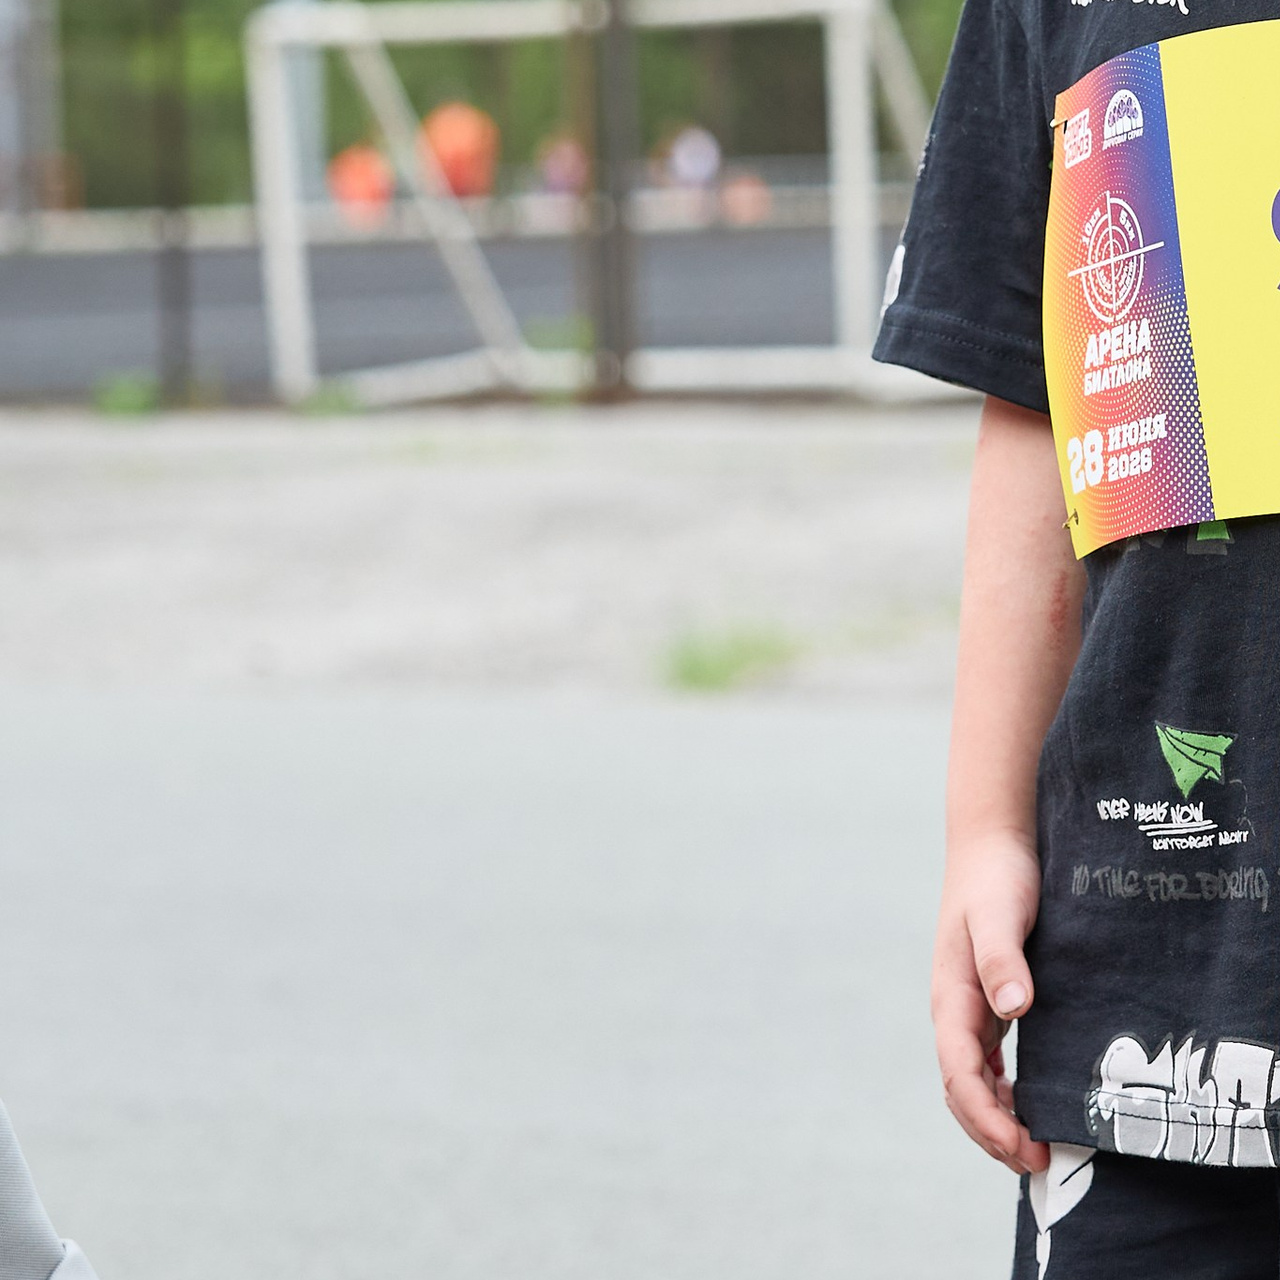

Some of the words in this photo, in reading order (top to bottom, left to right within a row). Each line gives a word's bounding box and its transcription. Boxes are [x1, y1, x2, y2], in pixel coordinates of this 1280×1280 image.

[1084, 317, 1152, 370] АРЕНА
[1083, 355, 1152, 397] БИАТЛОНА
[1066, 429, 1105, 495] 28
[1107, 413, 1168, 453] ИЮНЯ
[1107, 446, 1153, 483] 2026
